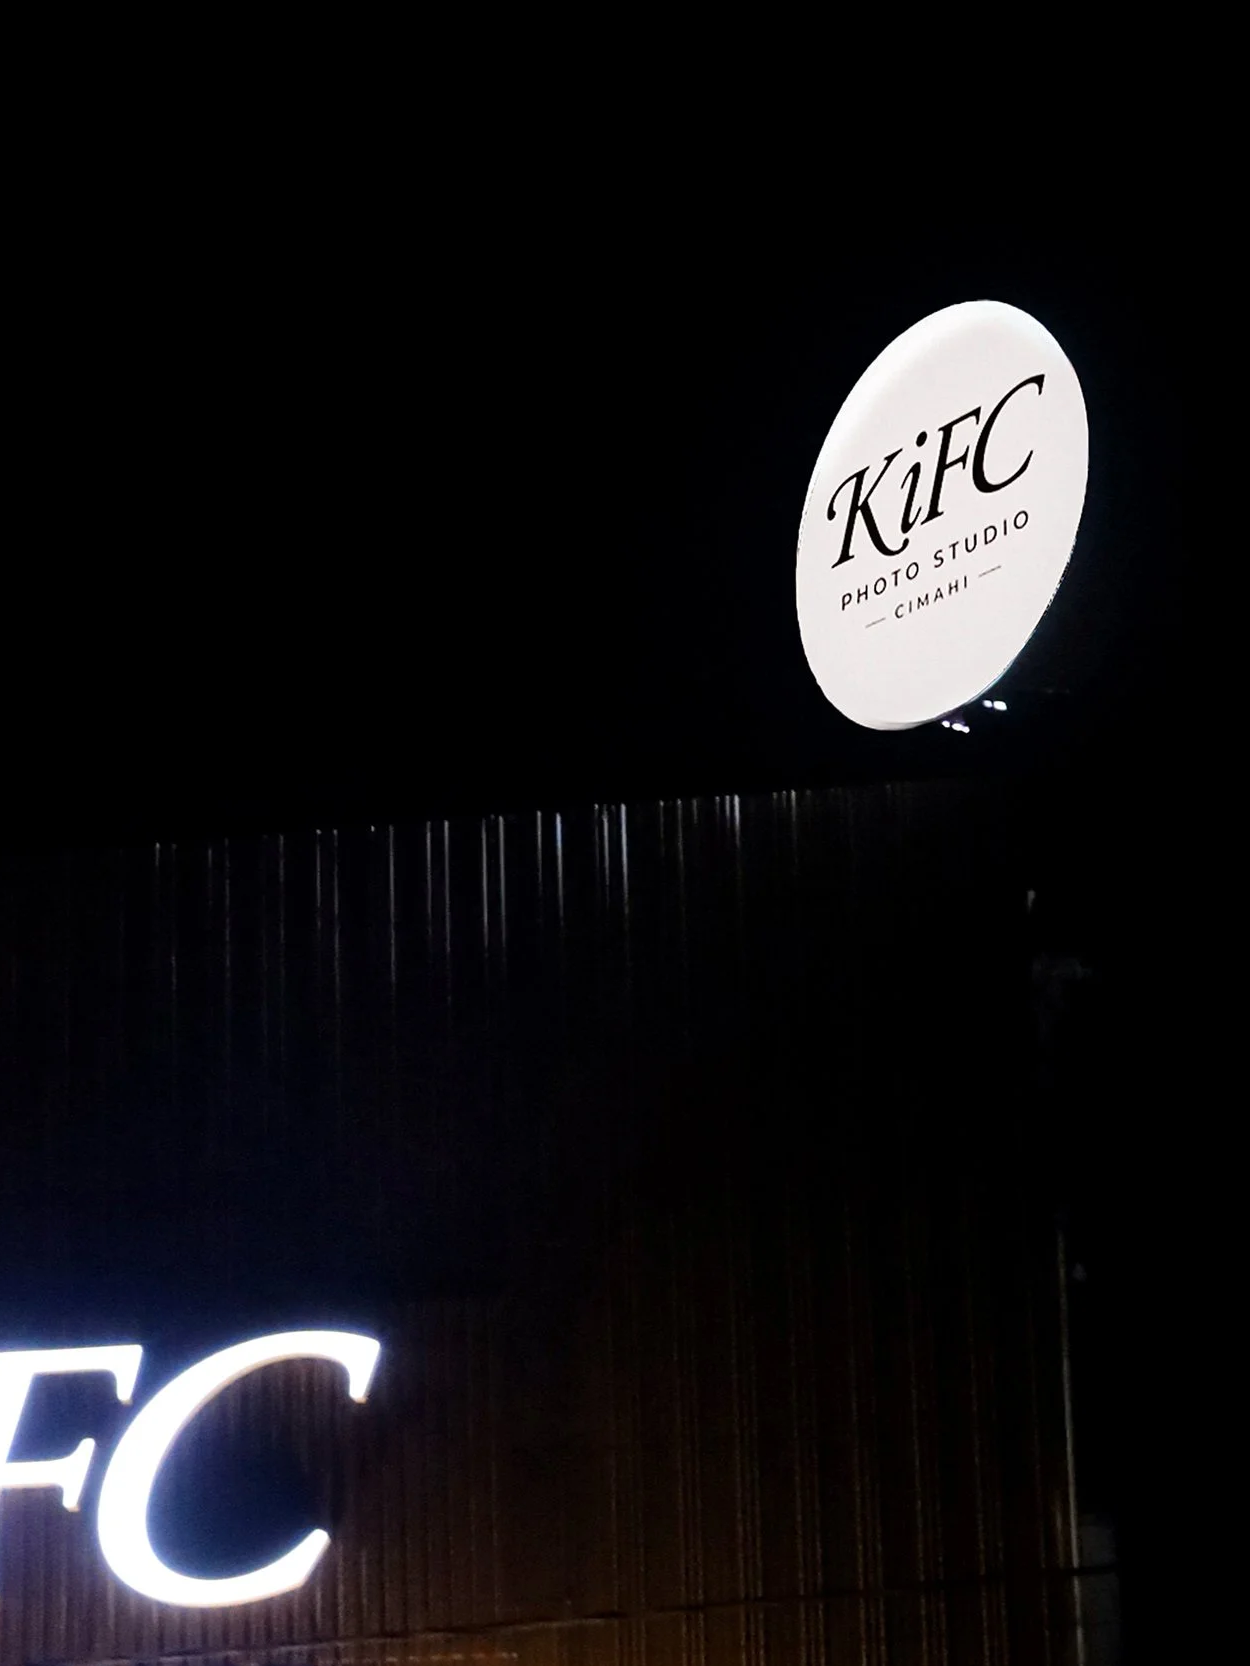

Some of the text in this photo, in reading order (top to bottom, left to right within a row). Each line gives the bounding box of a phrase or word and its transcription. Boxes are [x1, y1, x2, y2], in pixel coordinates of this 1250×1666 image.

[826, 373, 1046, 570] KiFC
[840, 509, 1030, 612] PHOTO STUDIO
[893, 575, 968, 620] CIMAHI
